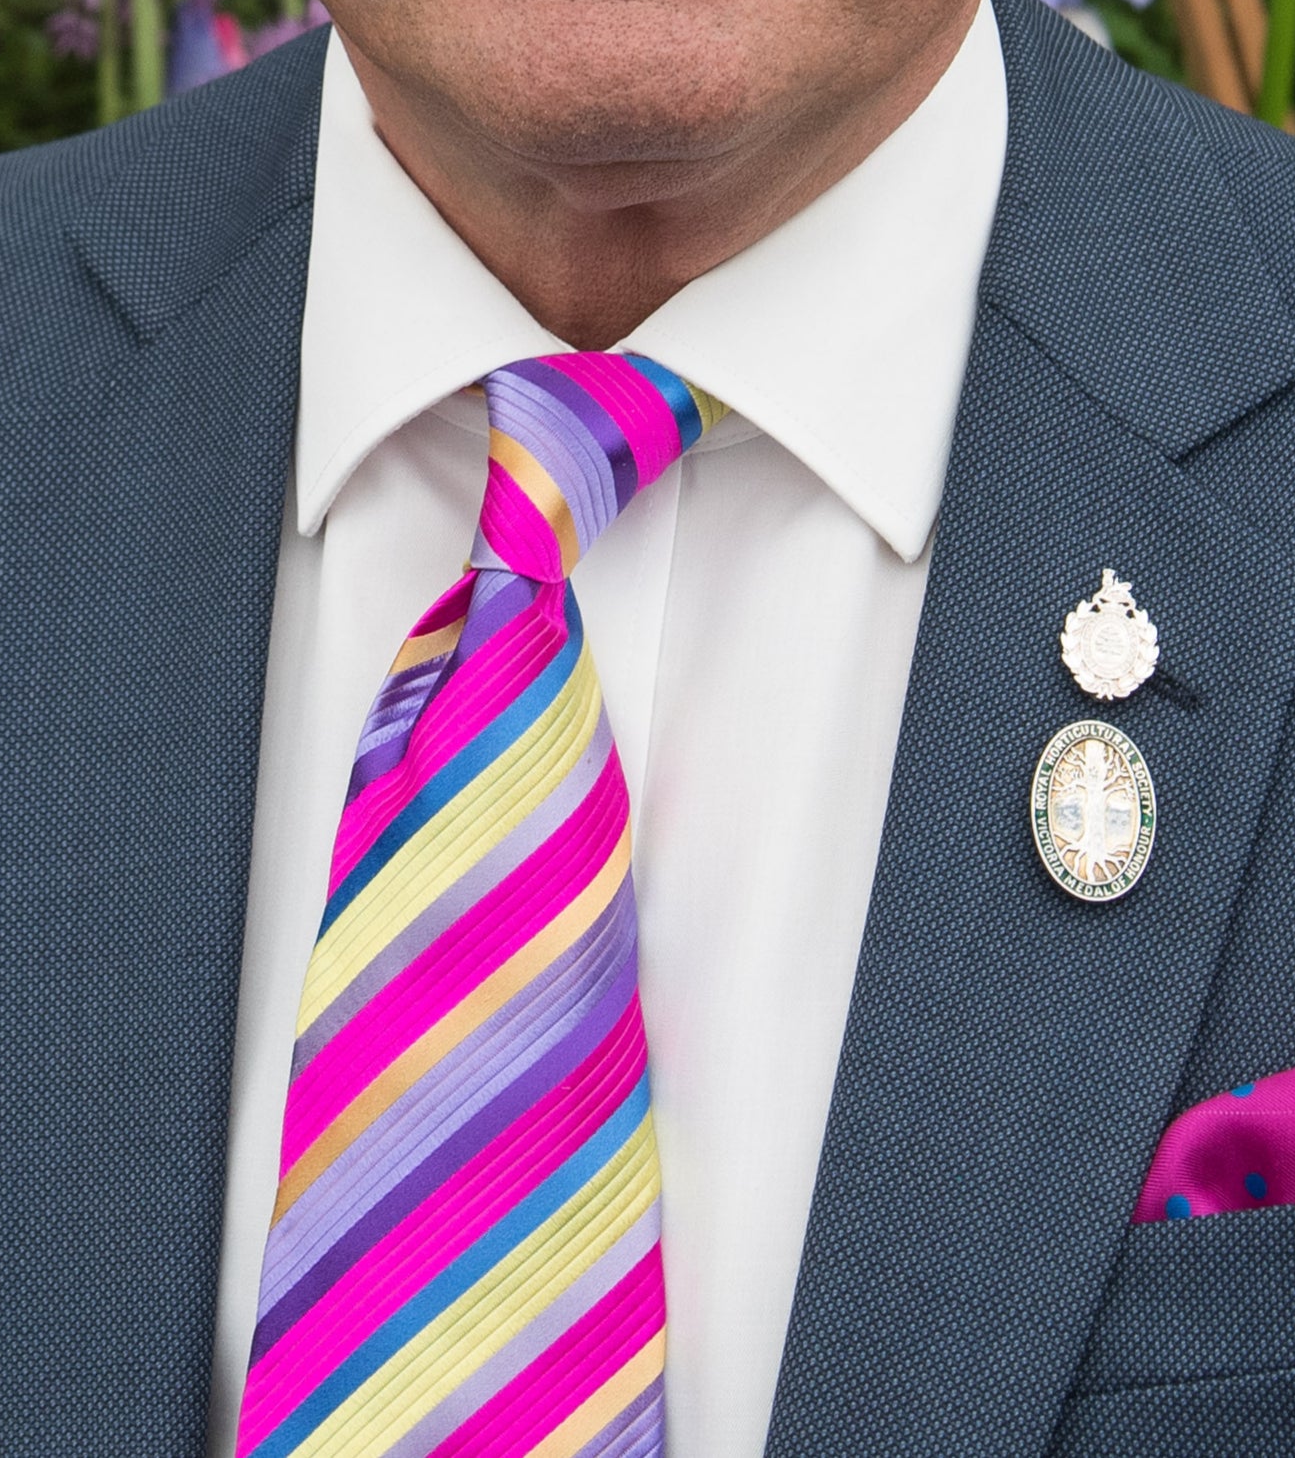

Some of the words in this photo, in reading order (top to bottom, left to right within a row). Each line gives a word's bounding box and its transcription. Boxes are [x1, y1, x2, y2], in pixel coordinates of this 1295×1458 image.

[1035, 769, 1052, 810] ROYAL
[1045, 724, 1136, 766] HORTICULTURAL
[1131, 761, 1154, 817] SOCIETY
[1037, 817, 1066, 877] VICTORIA
[1063, 876, 1113, 897] MEDAL
[1110, 876, 1127, 893] OF
[1123, 825, 1152, 880] HONOUR
